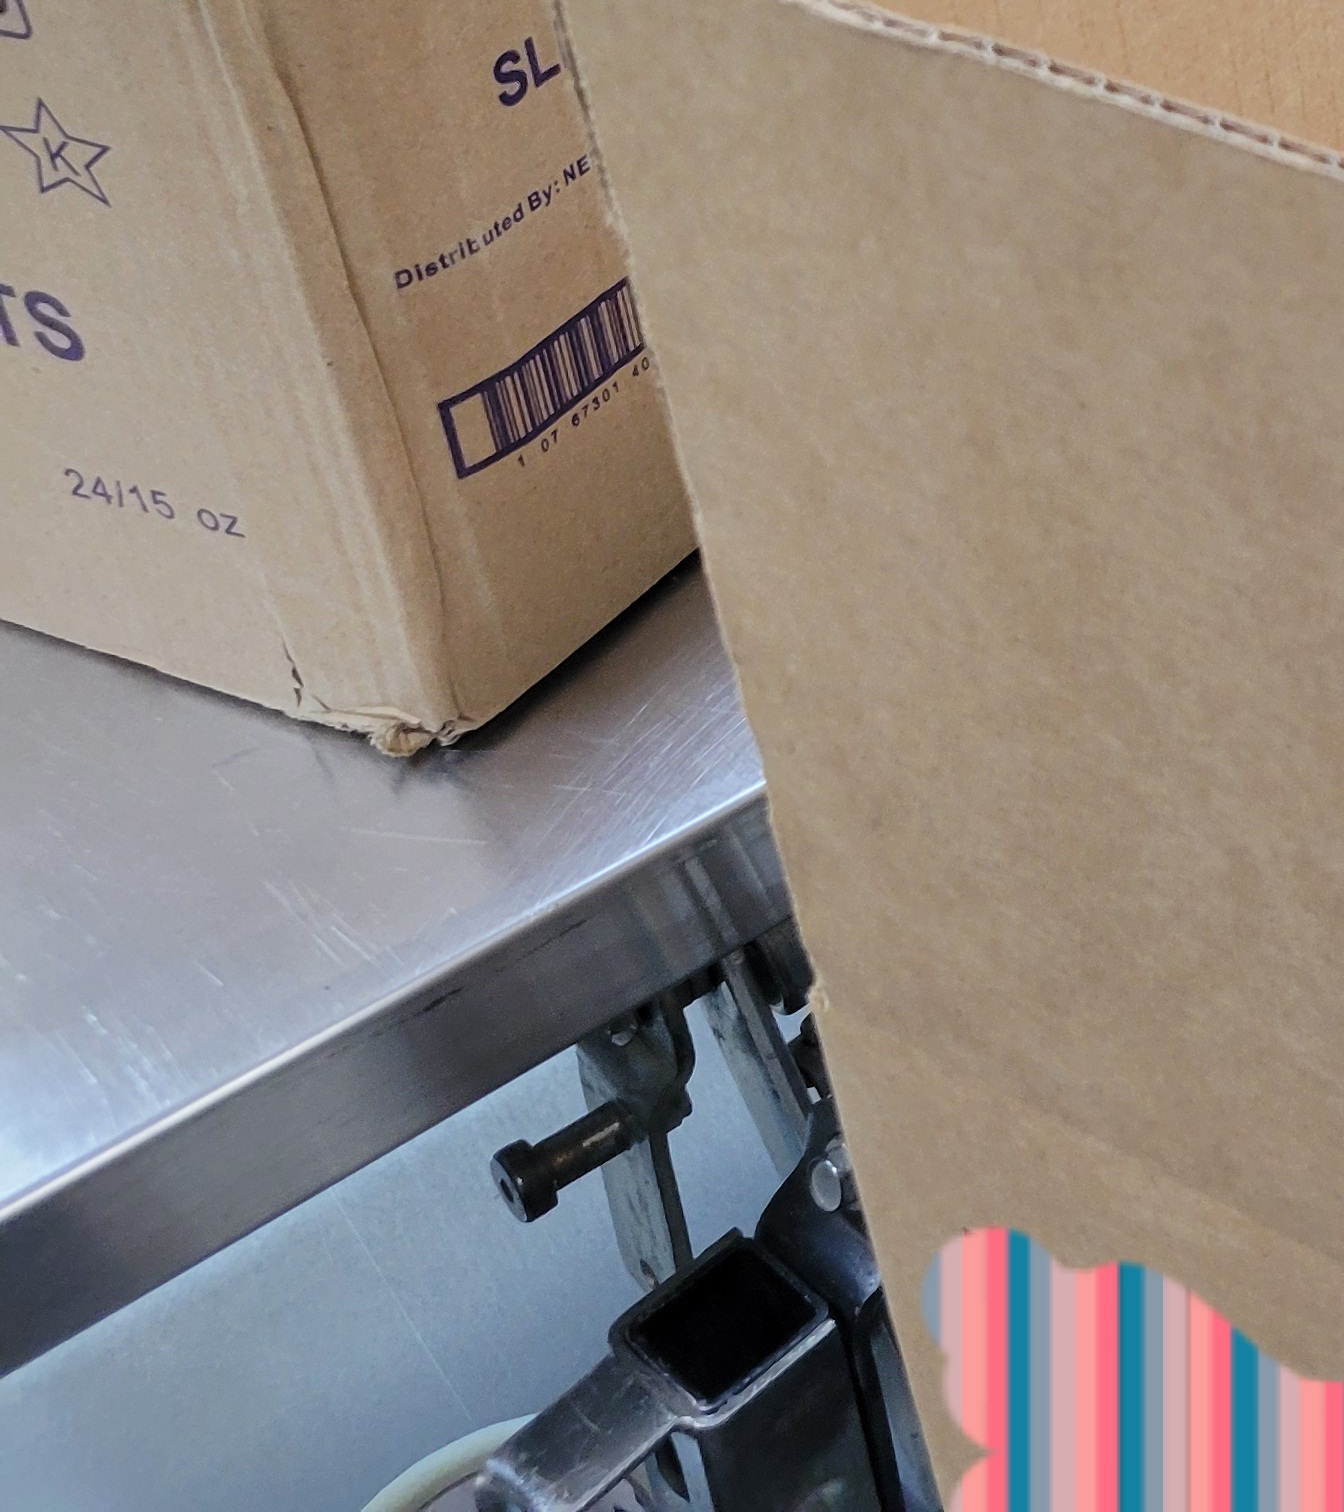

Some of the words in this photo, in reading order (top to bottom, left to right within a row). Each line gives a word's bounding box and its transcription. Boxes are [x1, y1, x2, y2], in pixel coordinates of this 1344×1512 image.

[493, 36, 562, 107] SL
[562, 154, 591, 185] NE
[64, 468, 175, 520] 24/15
